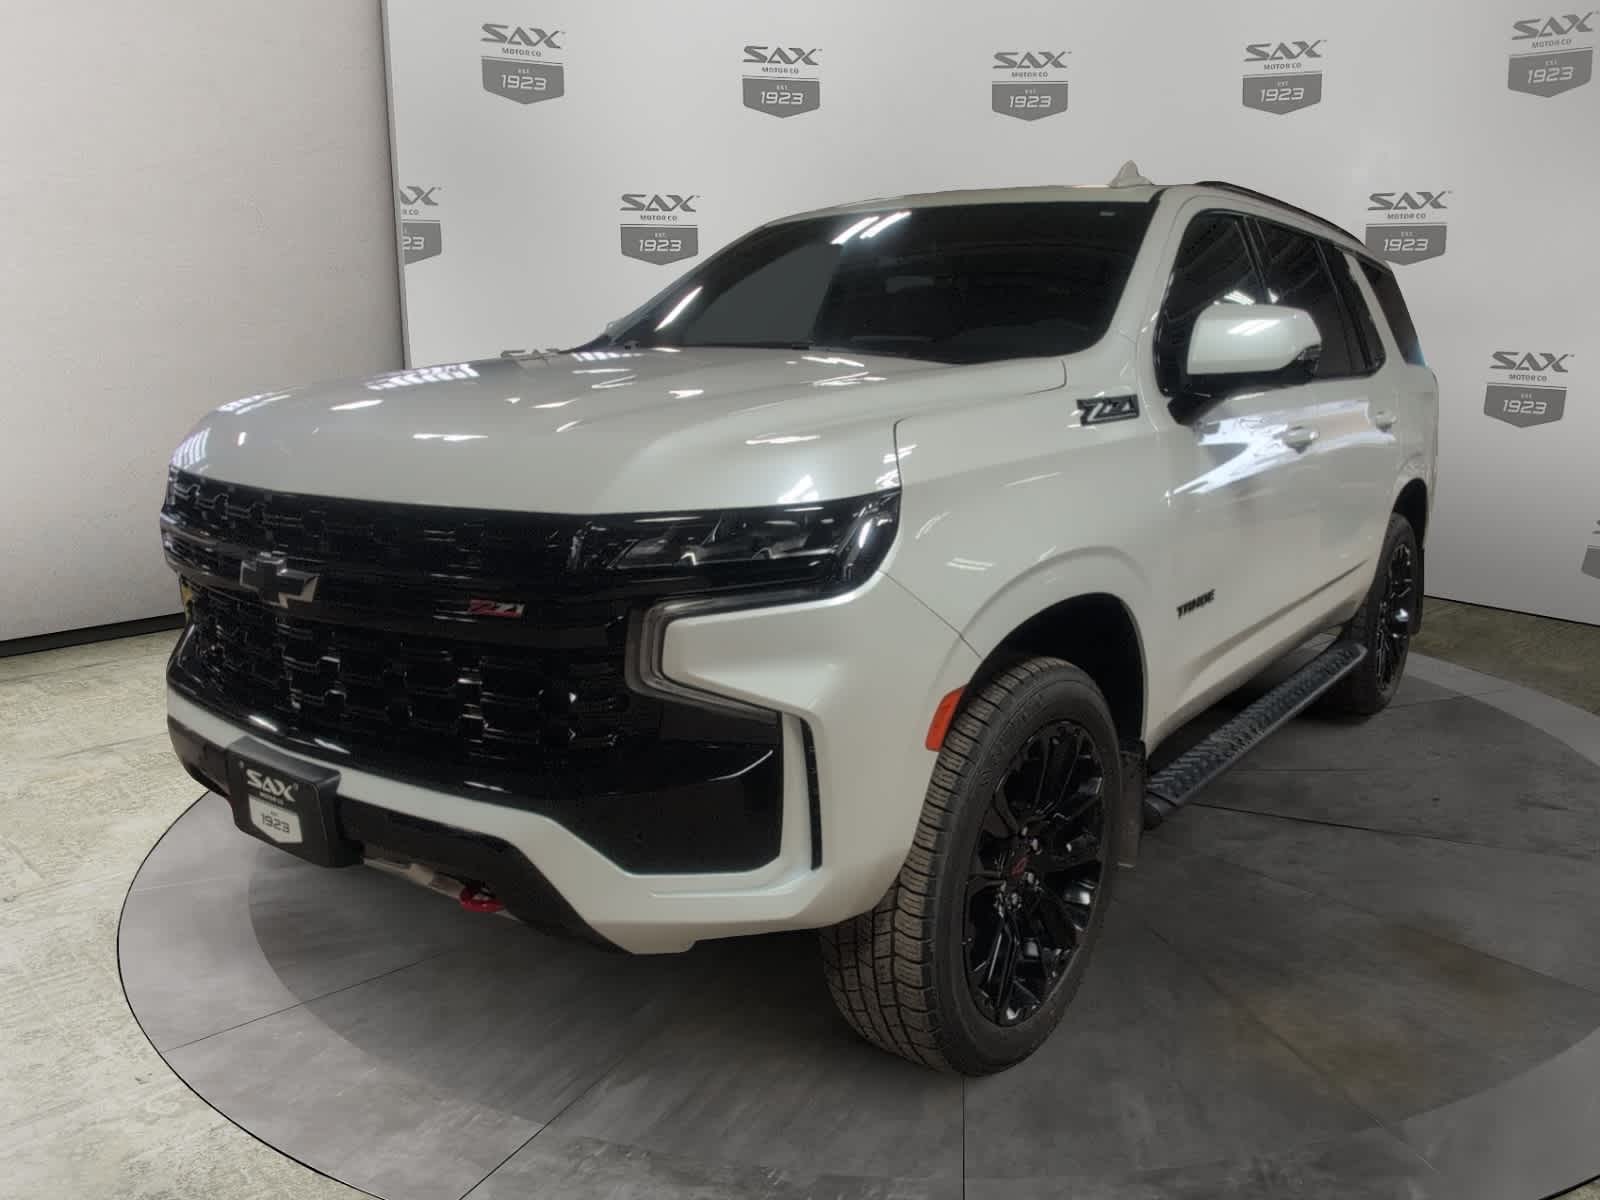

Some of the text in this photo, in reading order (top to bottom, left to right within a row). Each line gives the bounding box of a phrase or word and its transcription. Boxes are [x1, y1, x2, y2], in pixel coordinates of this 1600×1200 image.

[1511, 11, 1593, 40] SAX
[481, 24, 562, 49] SAX
[743, 46, 819, 66] SAX
[1243, 40, 1322, 61] SAX
[992, 51, 1067, 69] SAX
[501, 74, 547, 90] 1923
[1528, 66, 1574, 84] 1923
[761, 91, 804, 105] 1923
[1009, 96, 1052, 108] 1923
[1260, 88, 1305, 102] 1923
[620, 194, 697, 212] SAX
[1367, 191, 1448, 210] SAX
[402, 236, 425, 250] 23
[640, 239, 682, 252] 1923
[1383, 238, 1429, 252] 1923
[1489, 351, 1568, 373] SAX
[1503, 399, 1547, 414] 1923
[246, 768, 296, 802] SAX
[261, 812, 290, 834] 1923
